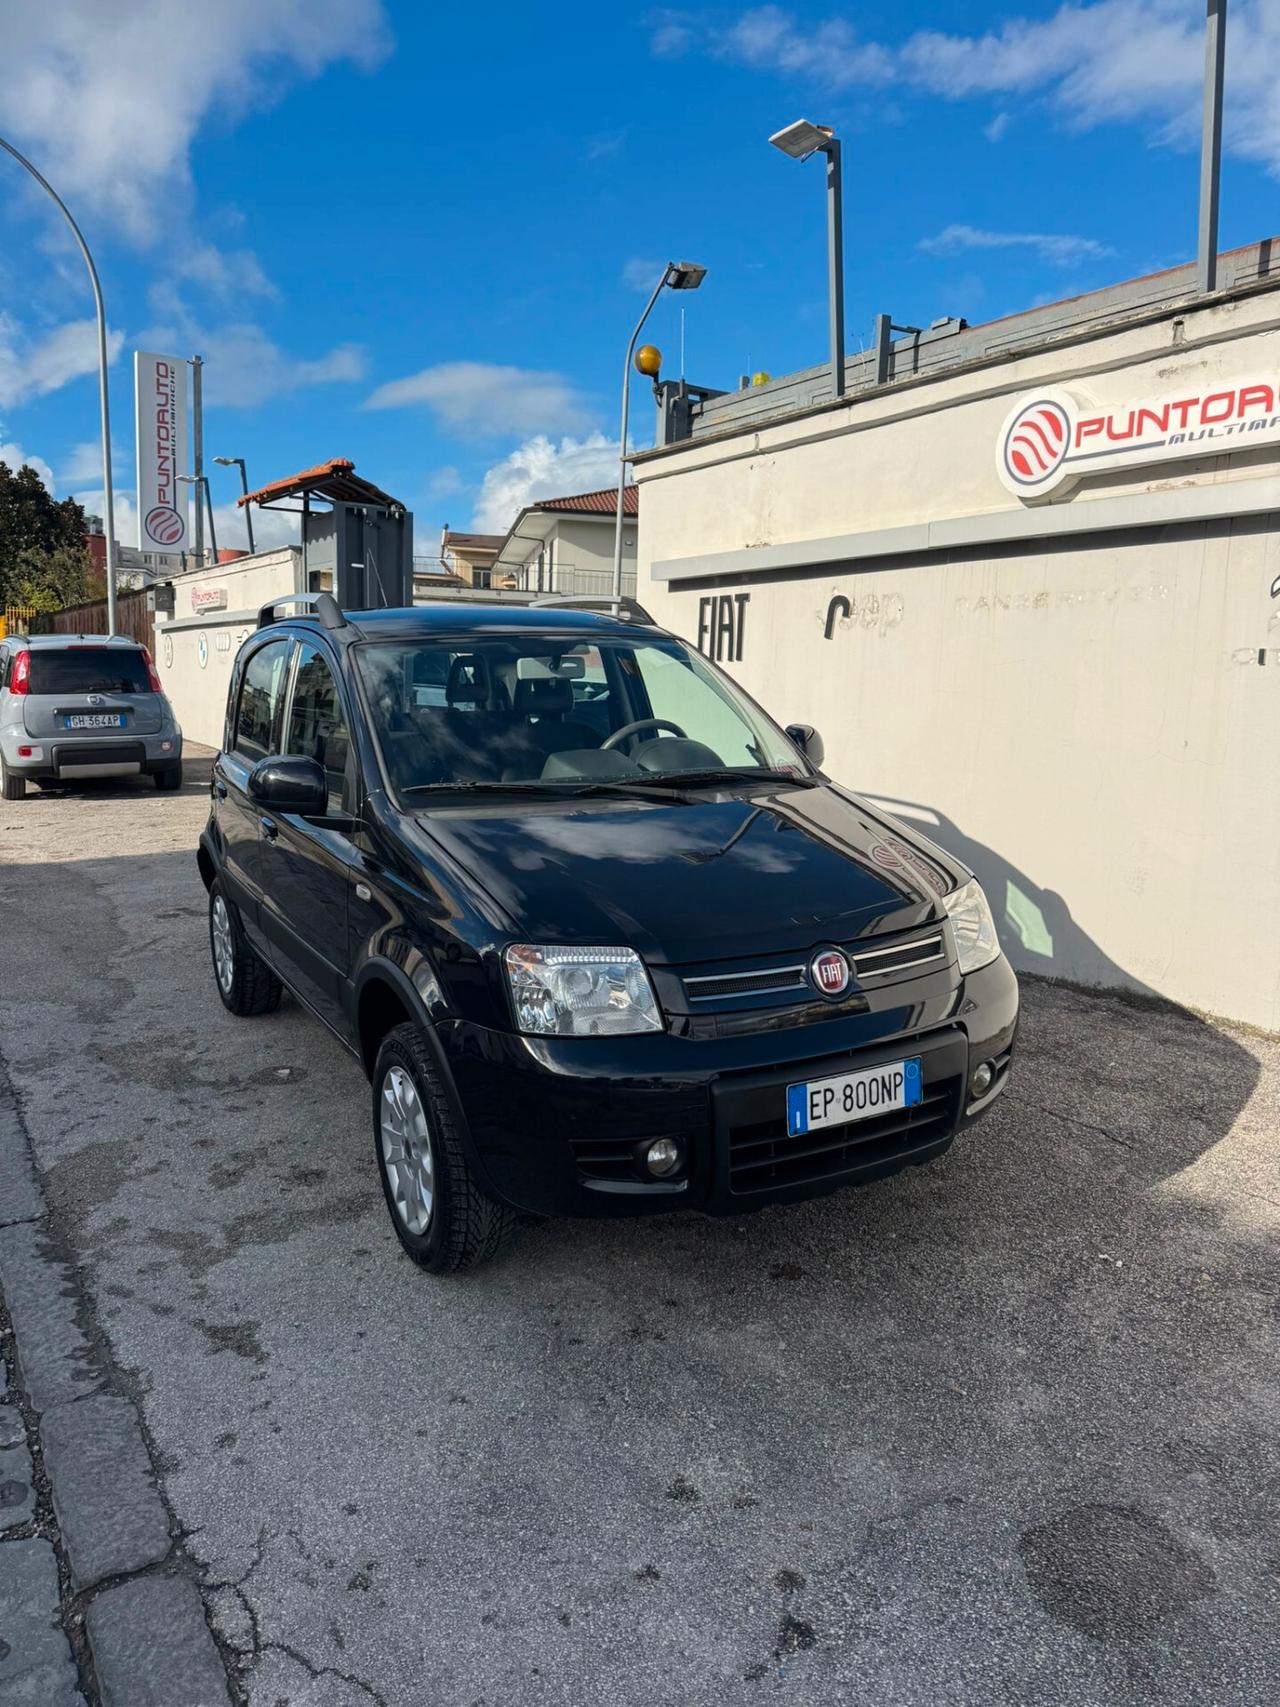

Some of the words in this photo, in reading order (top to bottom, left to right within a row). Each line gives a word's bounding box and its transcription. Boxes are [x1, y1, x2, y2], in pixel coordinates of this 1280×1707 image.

[156, 361, 170, 504] PUNTOAUTO
[1074, 384, 1280, 448] PUNTOA
[697, 592, 751, 662] FIAT
[821, 962, 842, 984] FIAT
[810, 1087, 835, 1121] EP
[842, 1071, 904, 1113] 800NP
